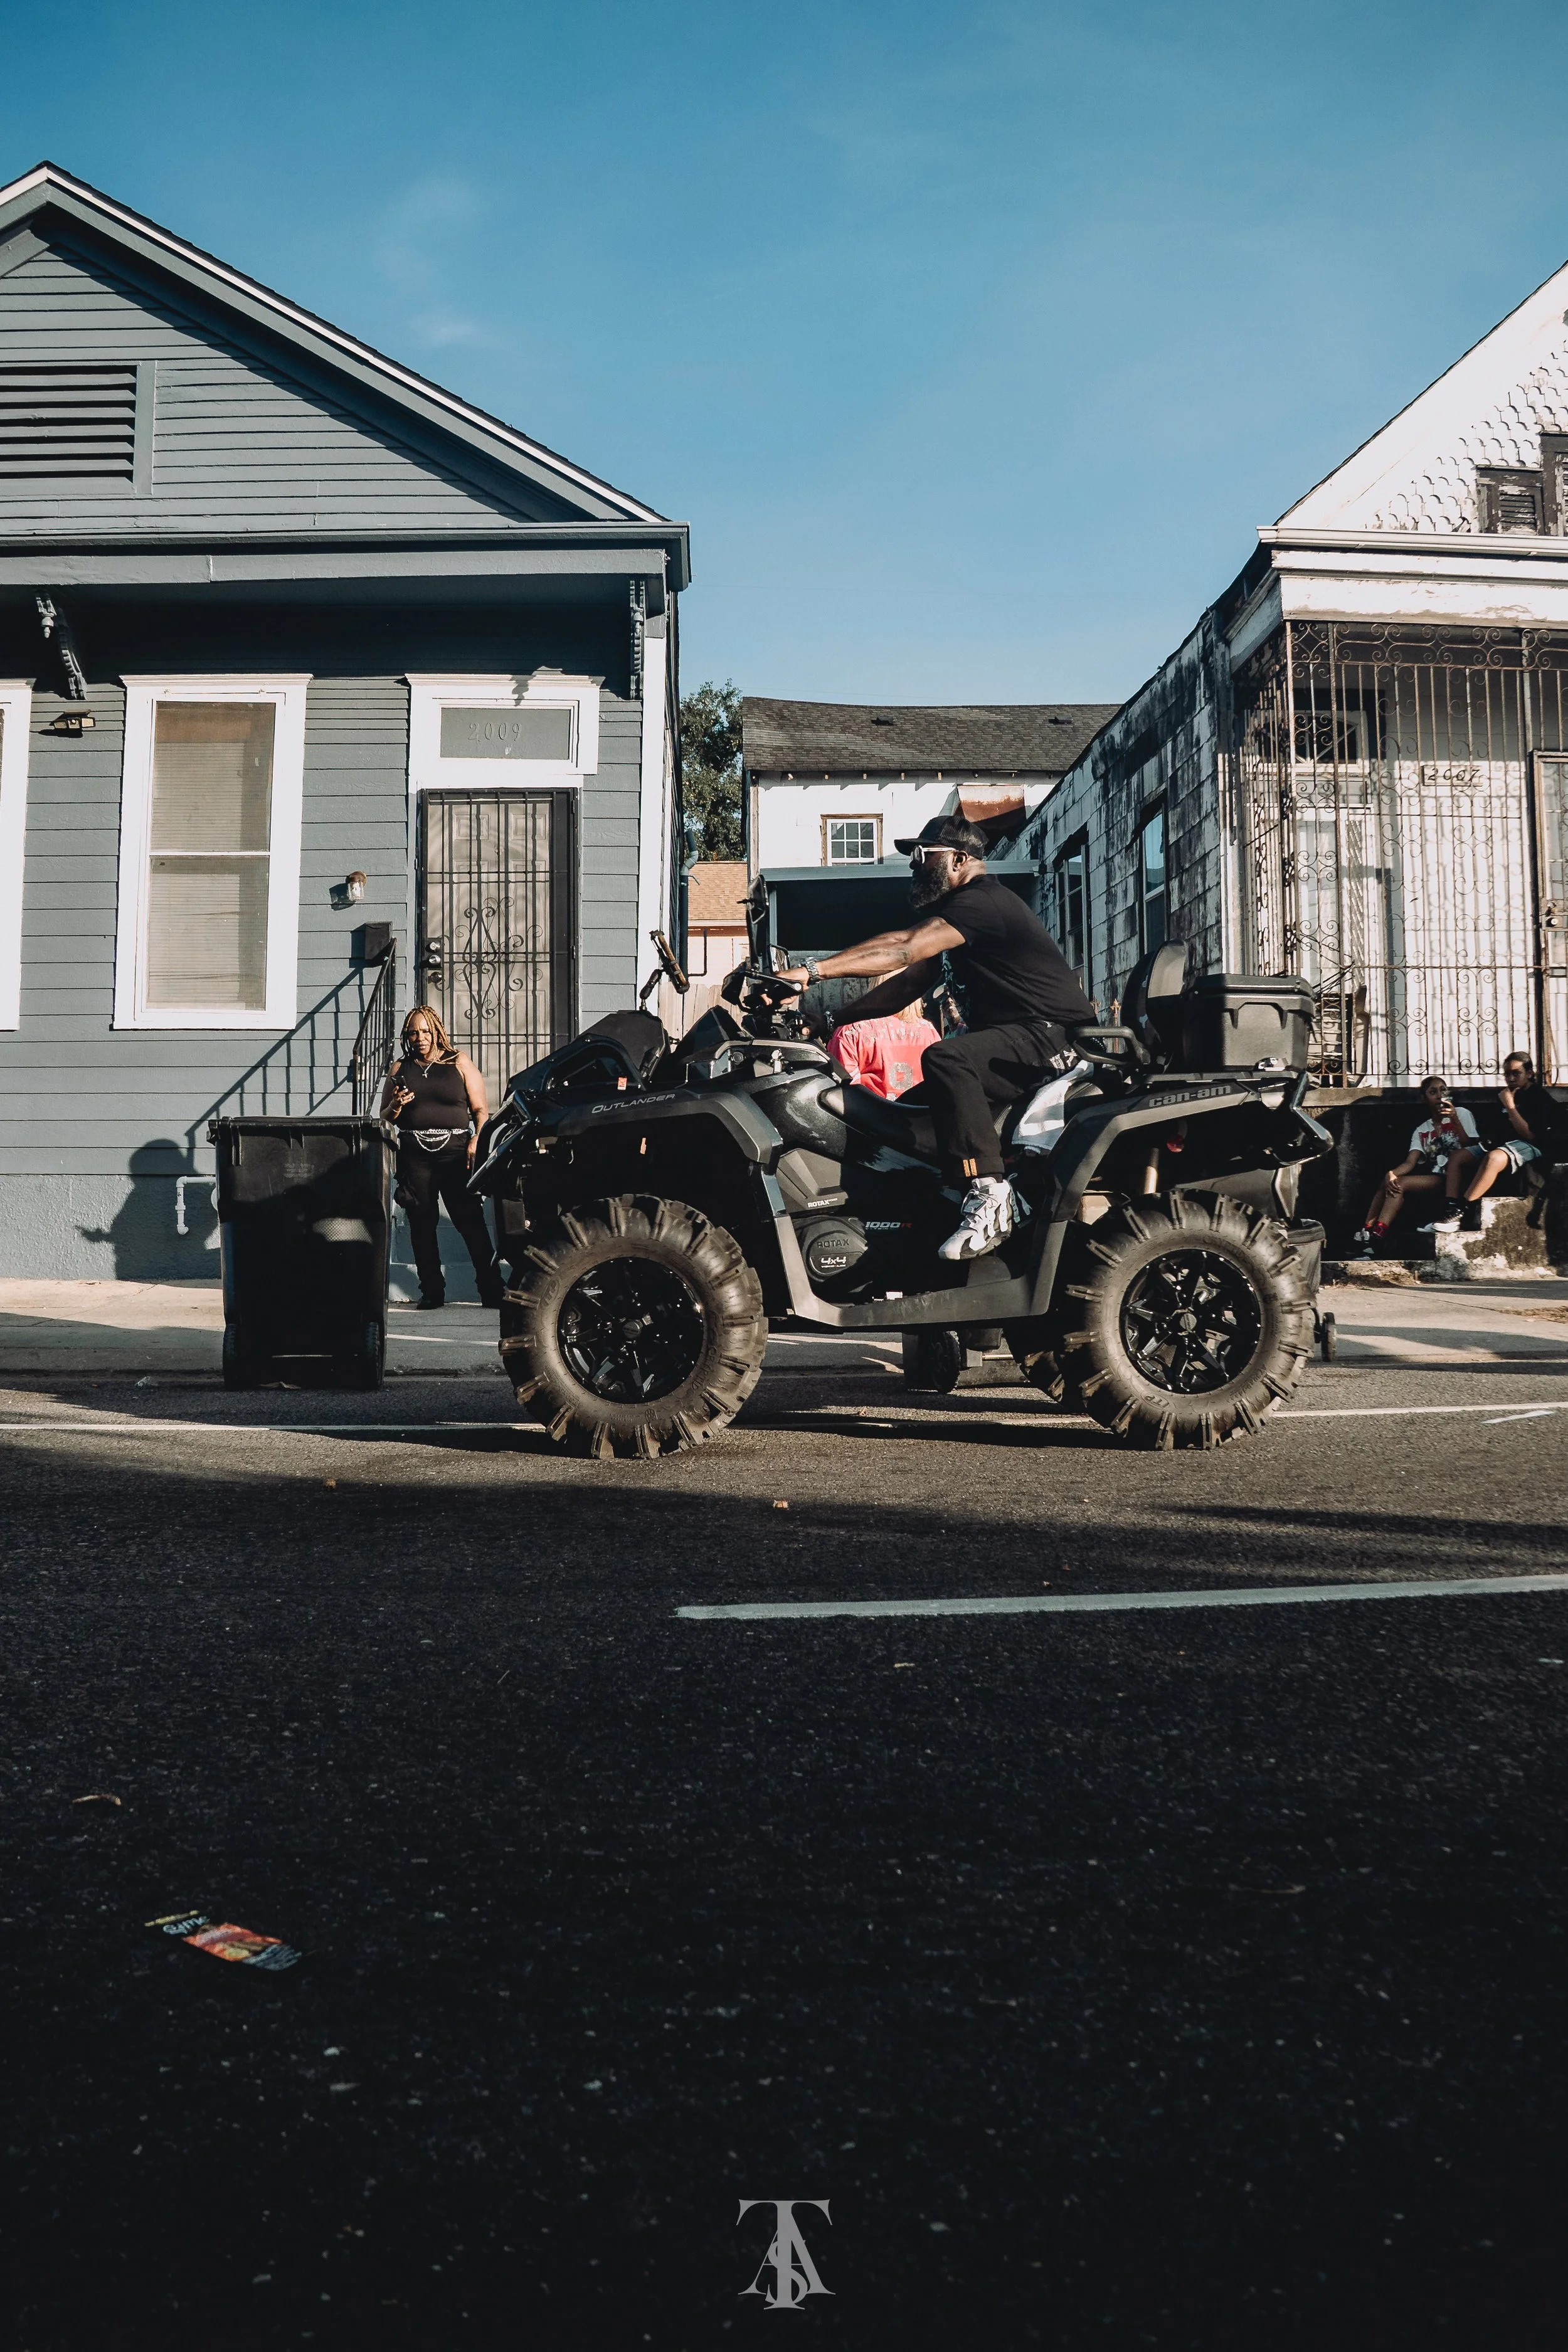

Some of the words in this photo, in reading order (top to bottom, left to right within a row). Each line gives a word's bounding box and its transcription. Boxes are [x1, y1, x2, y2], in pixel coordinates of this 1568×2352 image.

[468, 722, 522, 742] 2009
[591, 1093, 675, 1114] OUTLANDER
[1148, 1084, 1231, 1107] can-am
[807, 1199, 830, 1208] ROTAX
[817, 1238, 849, 1248] ROTAX
